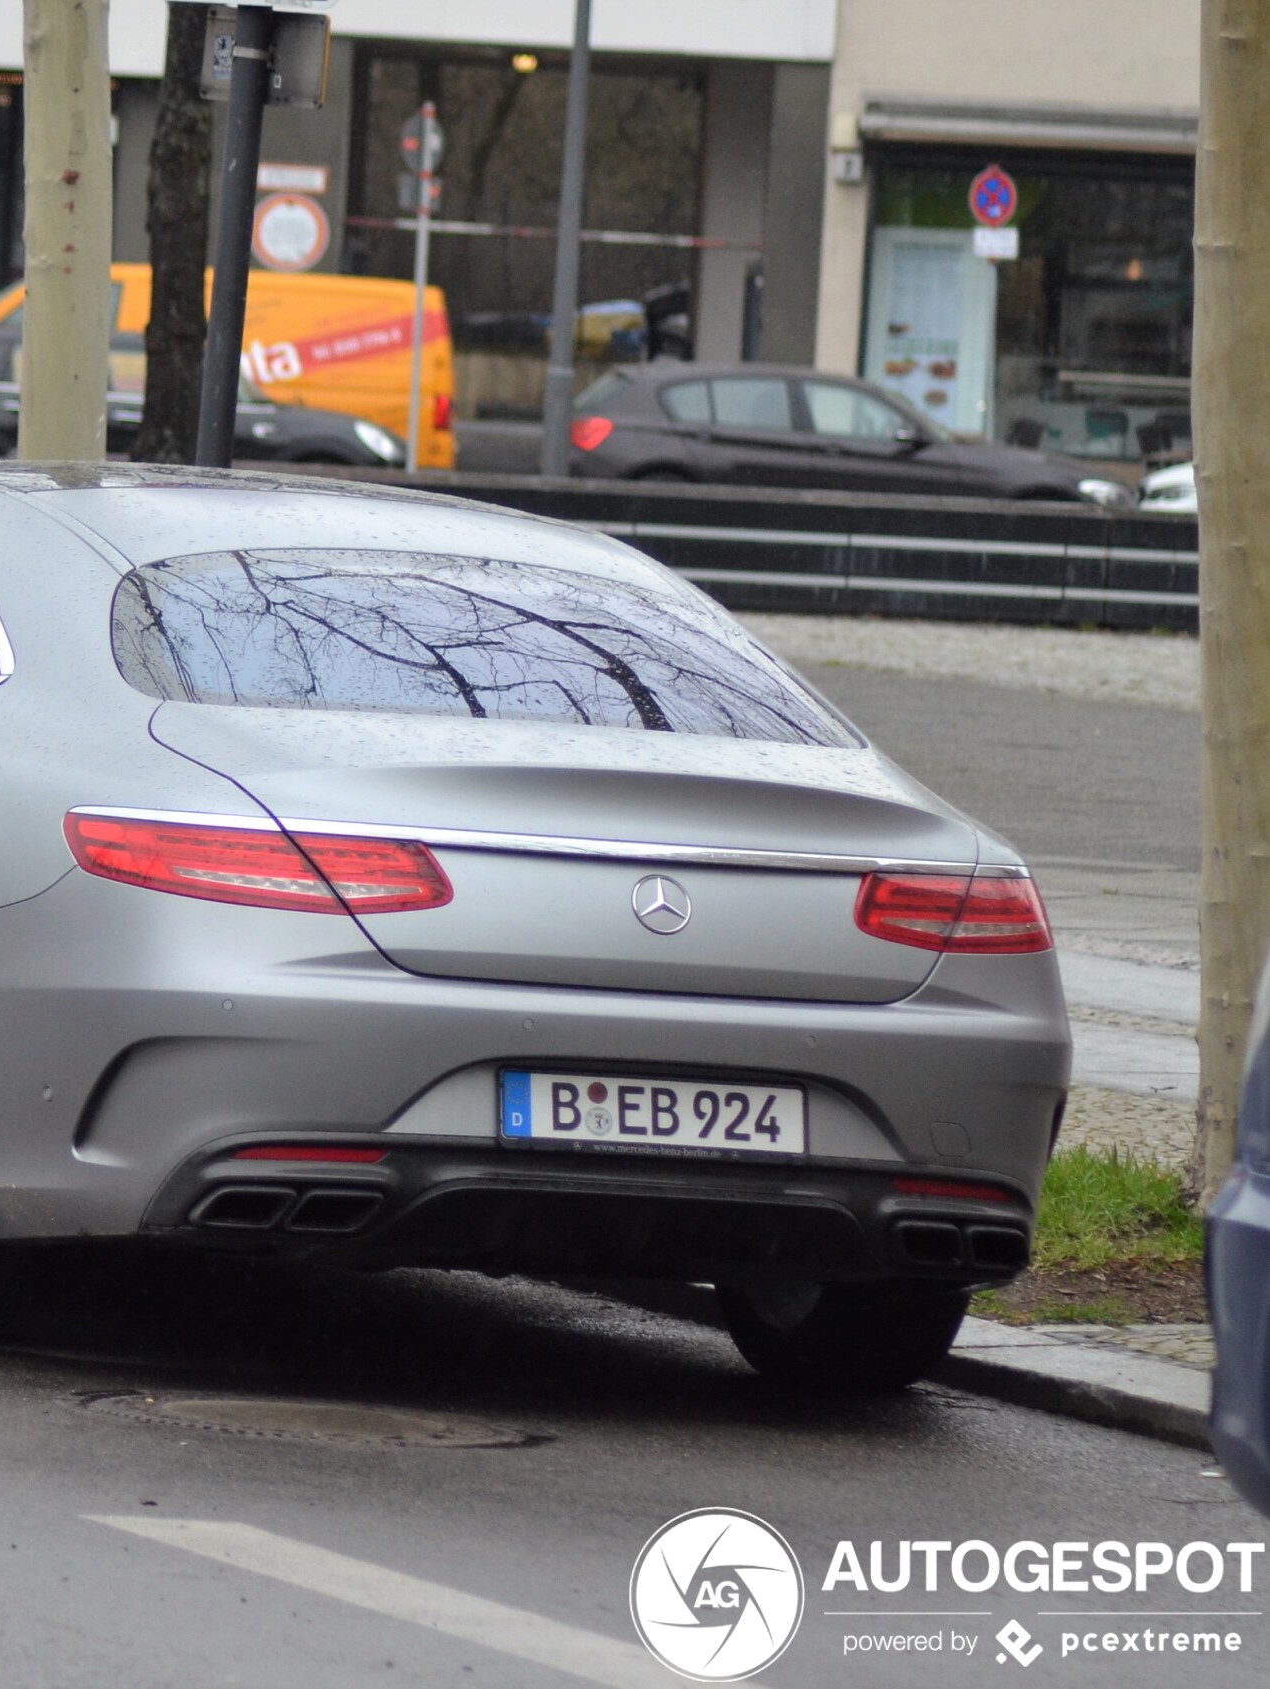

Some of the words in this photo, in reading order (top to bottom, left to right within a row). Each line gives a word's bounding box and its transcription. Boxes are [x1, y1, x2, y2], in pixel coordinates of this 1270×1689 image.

[511, 1111, 523, 1127] D
[551, 1081, 582, 1131] B
[617, 1085, 680, 1137] EB
[692, 1089, 781, 1143] 924
[593, 1143, 721, 1159] www.mercedes-benz-berlin.de
